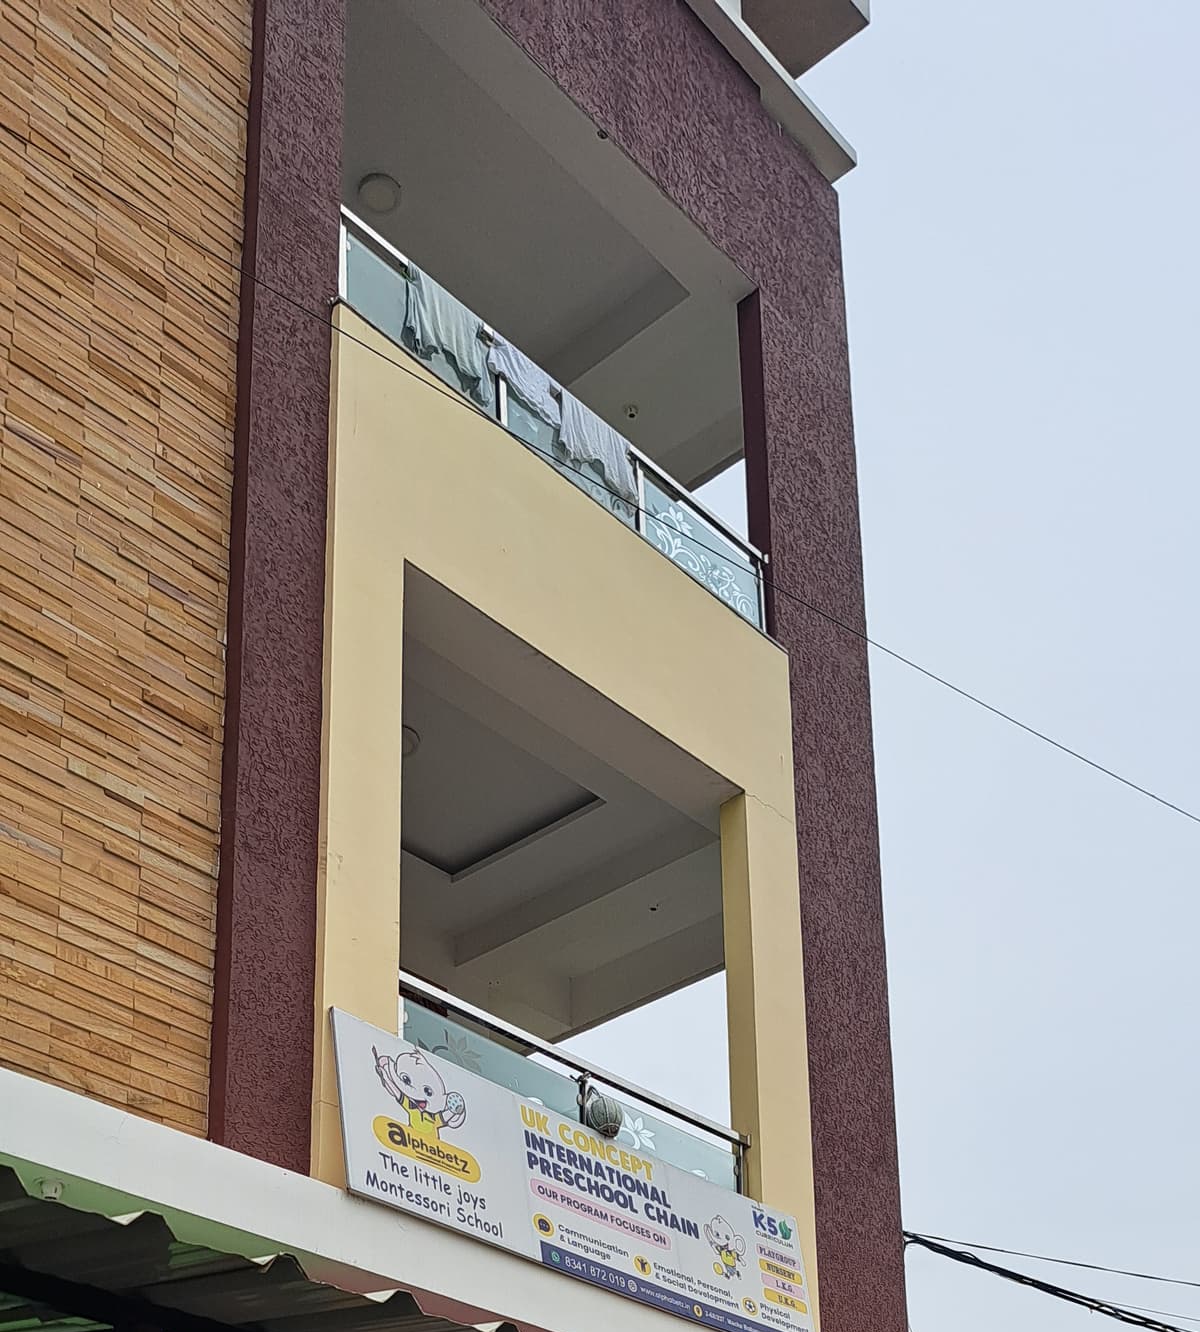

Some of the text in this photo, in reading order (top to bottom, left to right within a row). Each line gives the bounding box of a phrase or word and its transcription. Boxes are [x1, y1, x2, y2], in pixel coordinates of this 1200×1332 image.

[387, 1122, 470, 1174] alphabetz
[520, 1104, 653, 1181] UK CONCEPT
[379, 1152, 409, 1178] The
[414, 1165, 452, 1195] little
[457, 1185, 487, 1210] joys
[524, 1130, 671, 1209] INTERNATIONAL
[526, 1151, 700, 1239] PRESCHOOL CHAIN
[366, 1170, 503, 1238] Montessori School
[538, 1185, 667, 1246] OUR PROGRAM FOCUSES ON
[752, 1210, 778, 1236] K5
[558, 1223, 630, 1258] Communication
[559, 1234, 612, 1260] & Language
[564, 1255, 626, 1288] 8341 872 019
[687, 1285, 739, 1310] Development
[760, 1302, 791, 1321] Physical
